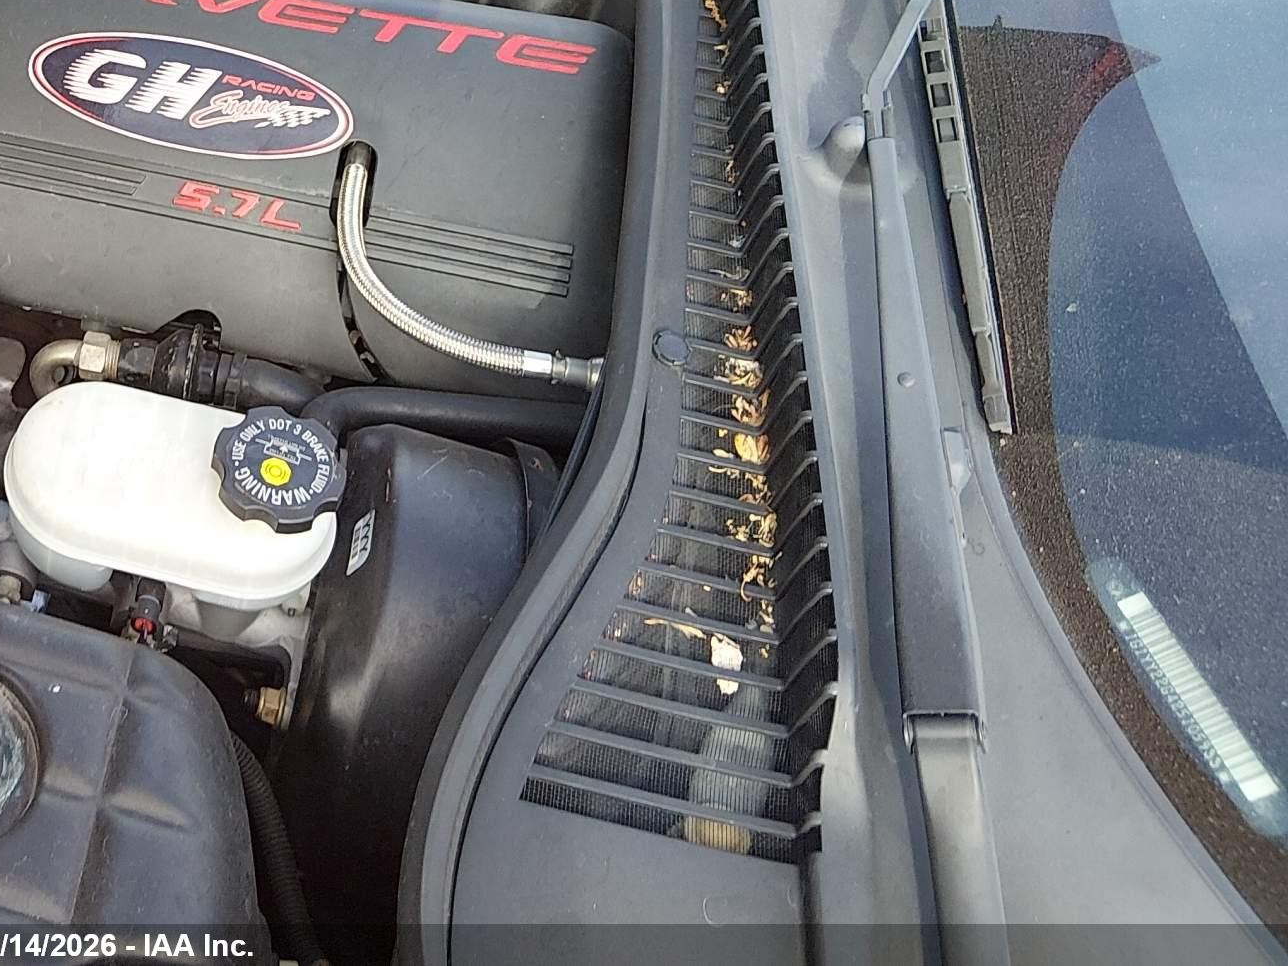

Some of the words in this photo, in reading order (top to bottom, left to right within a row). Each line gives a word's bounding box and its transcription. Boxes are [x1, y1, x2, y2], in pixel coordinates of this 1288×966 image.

[63, 47, 224, 122] GH
[221, 74, 316, 102] RACING
[172, 180, 303, 232] 5.7L
[239, 419, 265, 443] ONLY
[268, 418, 293, 432] DOT
[293, 423, 302, 436] 3
[232, 440, 247, 461] USE
[301, 429, 329, 463] BRAKE
[234, 466, 312, 506] WARNING
[310, 463, 331, 493] FLUID
